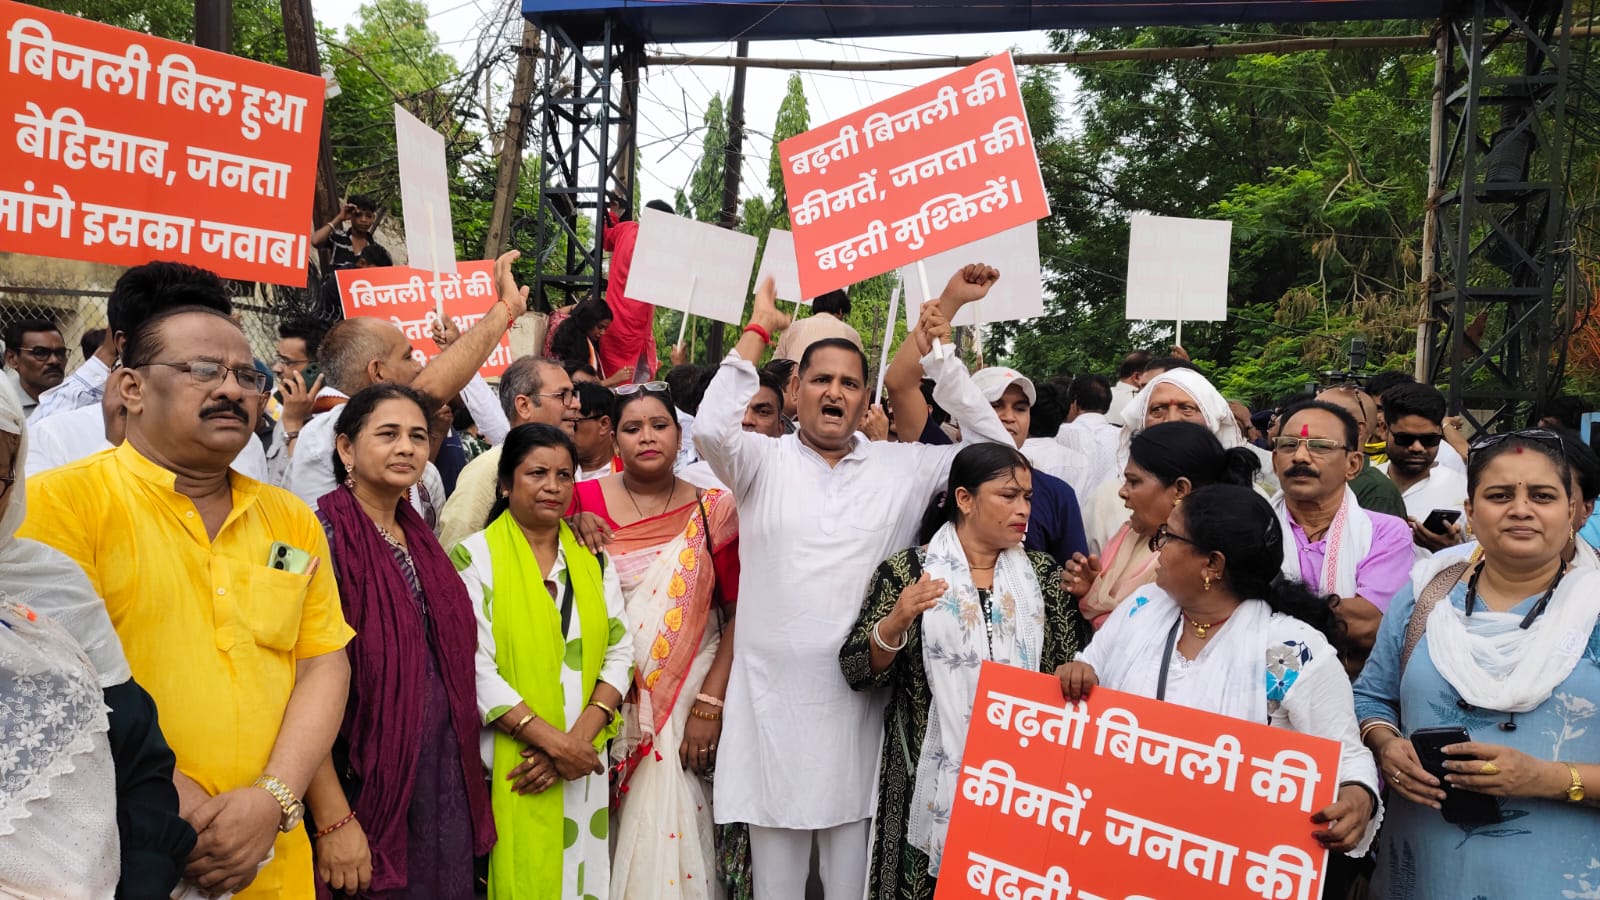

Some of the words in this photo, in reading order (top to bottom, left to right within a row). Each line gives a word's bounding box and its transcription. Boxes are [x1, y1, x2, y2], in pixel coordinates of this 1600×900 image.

[6, 18, 152, 101] बिजली
[157, 53, 236, 116] बिल
[240, 84, 308, 140] हुआ
[788, 124, 860, 175] बढ़ती
[861, 85, 960, 149] बिजली
[961, 67, 1007, 108] की
[14, 101, 177, 186] बेहिसाब,
[186, 146, 292, 200] जनता
[791, 167, 887, 226] कीमतें,
[888, 138, 978, 188] जनता
[979, 115, 1026, 156] की
[81, 202, 195, 254] इसका
[200, 220, 307, 269] जवाब।
[814, 219, 889, 272] बढ़ती
[890, 175, 1024, 251] मुश्किलें।
[349, 275, 427, 308] बिजली
[463, 270, 493, 298] की
[986, 690, 1091, 750] बढ़ती
[1094, 707, 1245, 792] बिजली
[1250, 749, 1322, 813] की
[962, 759, 1093, 847] कीमतें,
[1105, 807, 1240, 886] जनता
[1245, 844, 1318, 900] की
